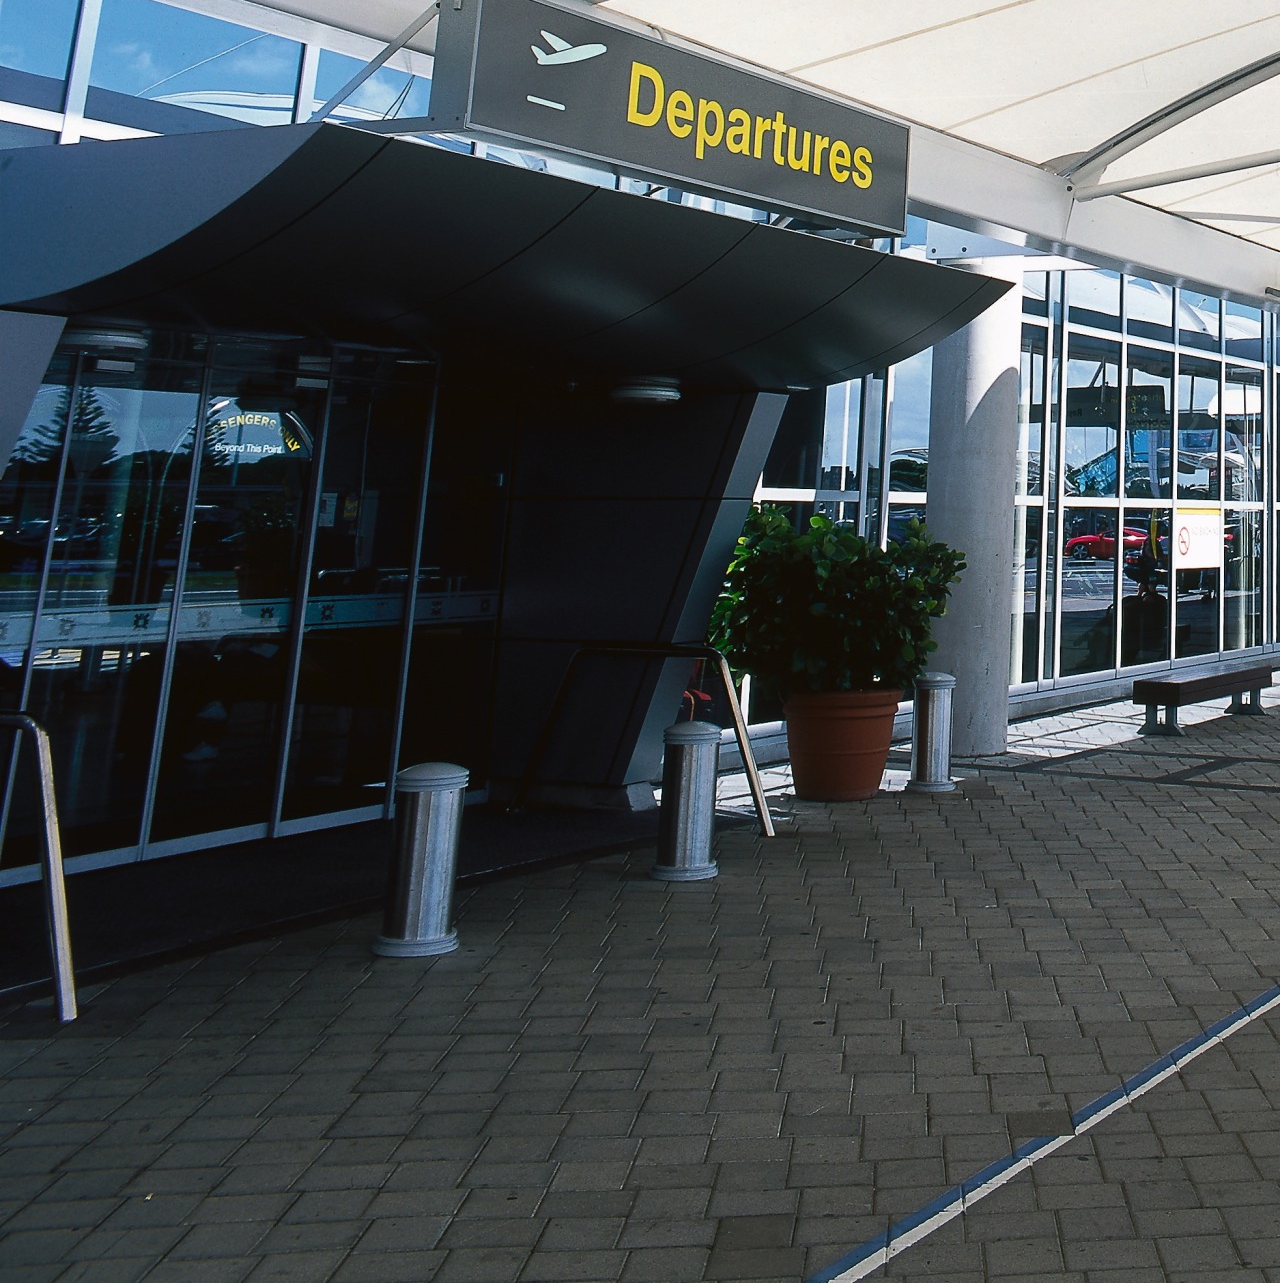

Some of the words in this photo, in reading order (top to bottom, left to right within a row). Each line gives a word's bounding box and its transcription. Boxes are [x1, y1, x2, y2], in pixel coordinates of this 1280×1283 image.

[627, 61, 873, 190] Departures
[214, 443, 244, 453] Beyond
[246, 443, 261, 452] This
[262, 445, 282, 454] Point
